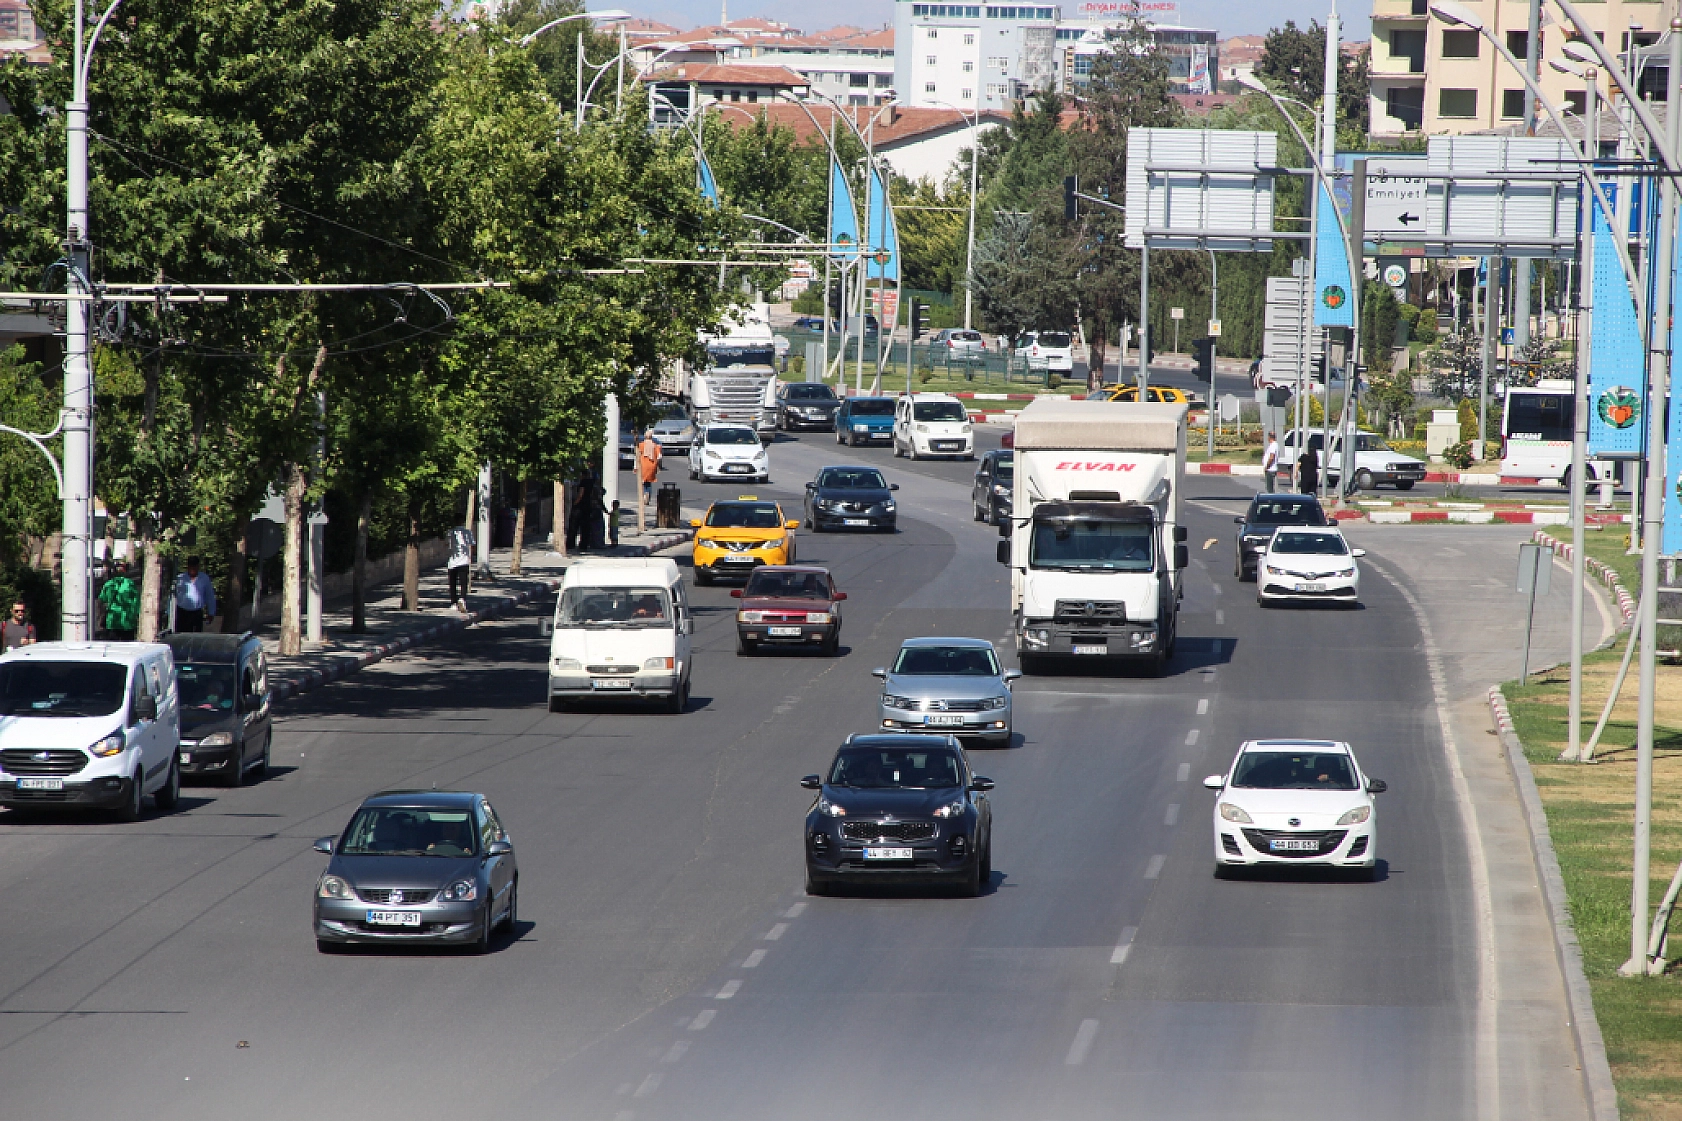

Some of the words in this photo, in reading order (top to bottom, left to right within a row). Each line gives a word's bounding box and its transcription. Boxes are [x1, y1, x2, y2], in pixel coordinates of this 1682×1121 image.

[1367, 187, 1420, 200] Emniyet
[1055, 461, 1138, 472] ELVAN
[385, 912, 399, 923] PT
[401, 913, 418, 923] 351
